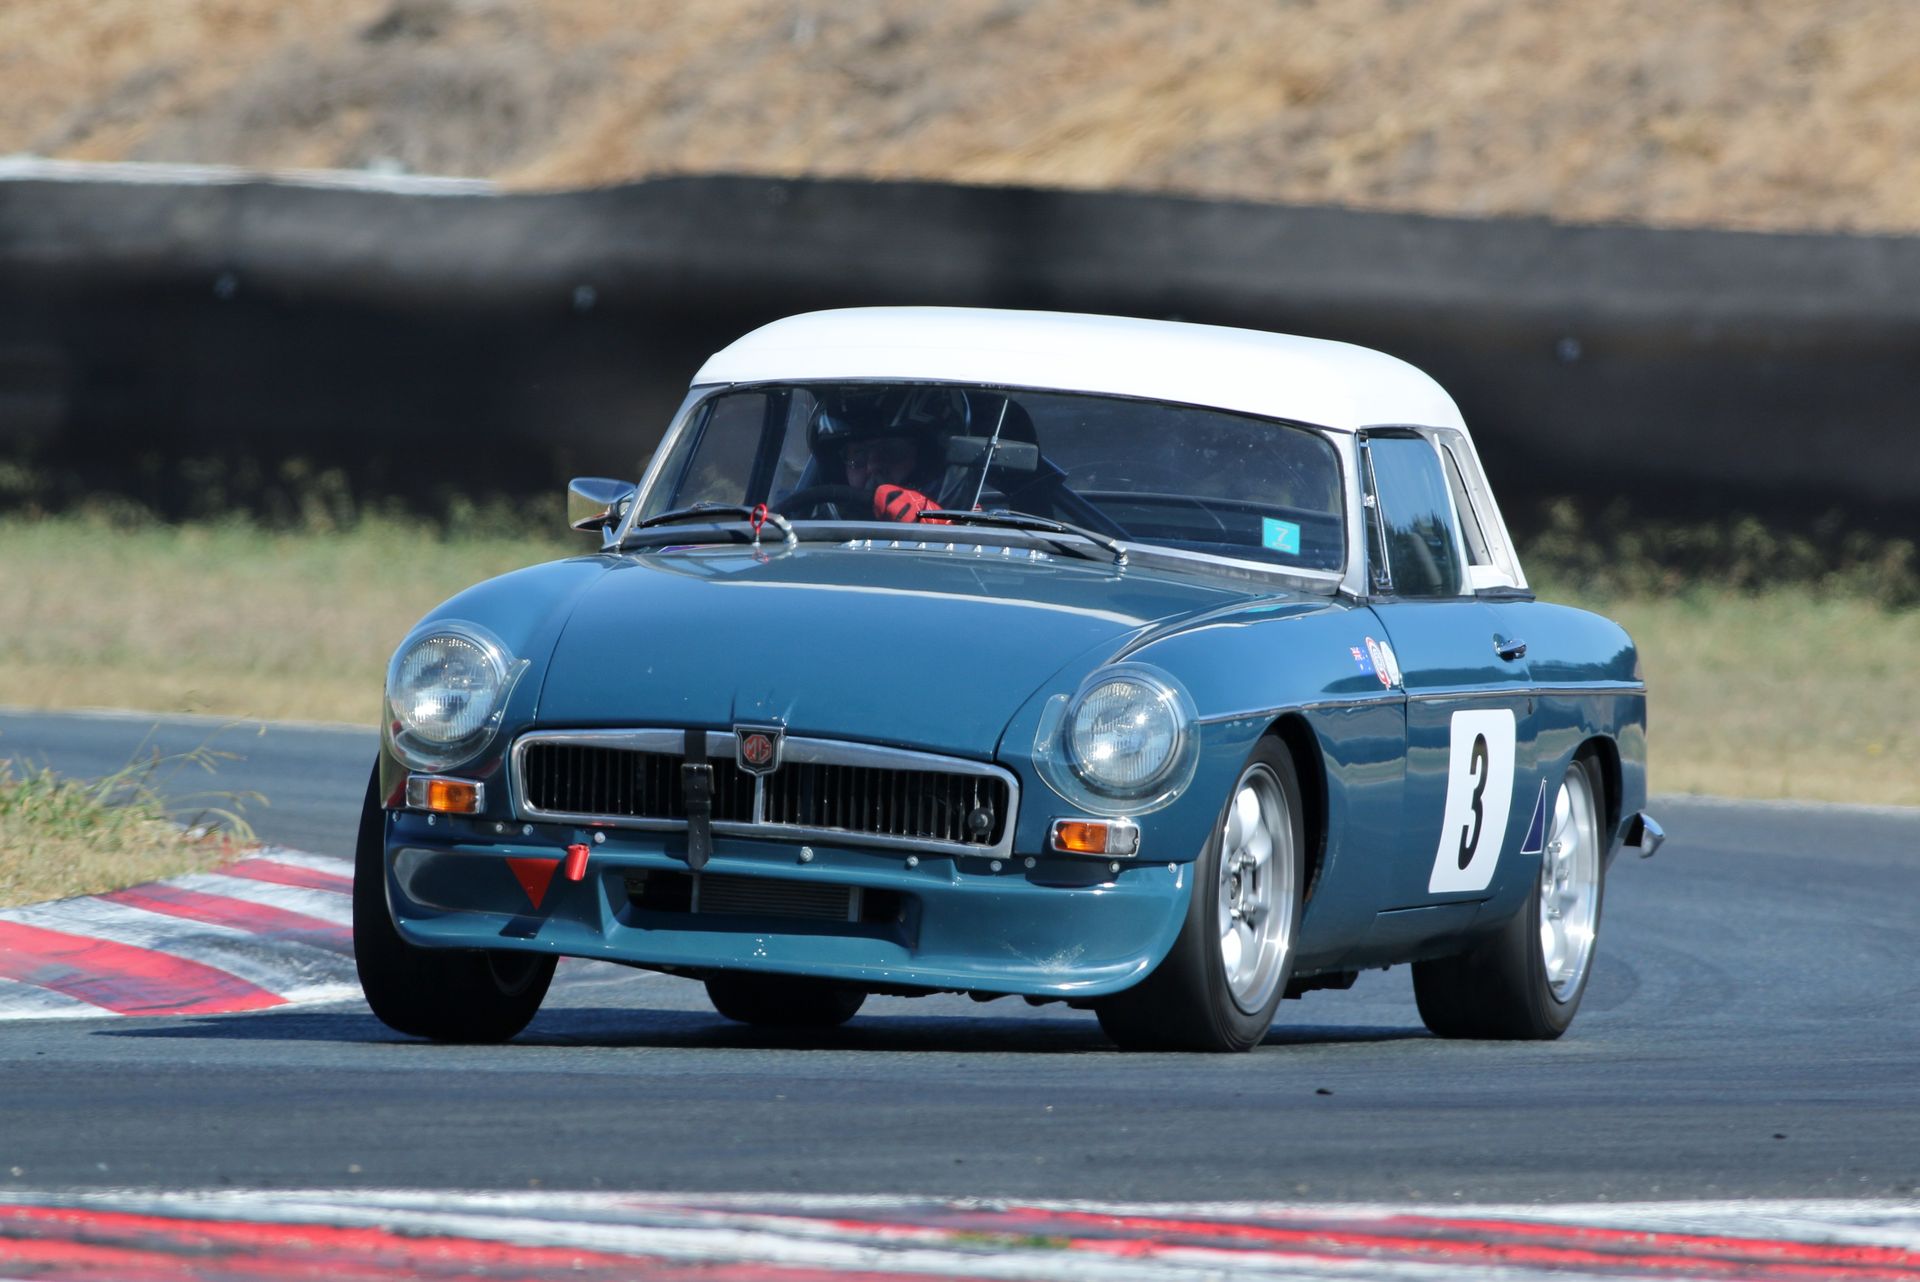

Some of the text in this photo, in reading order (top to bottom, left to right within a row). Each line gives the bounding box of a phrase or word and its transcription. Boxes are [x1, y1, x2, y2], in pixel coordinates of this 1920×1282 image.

[1275, 527, 1289, 543] 7
[746, 737, 770, 761] MG
[1457, 732, 1489, 871] 3
